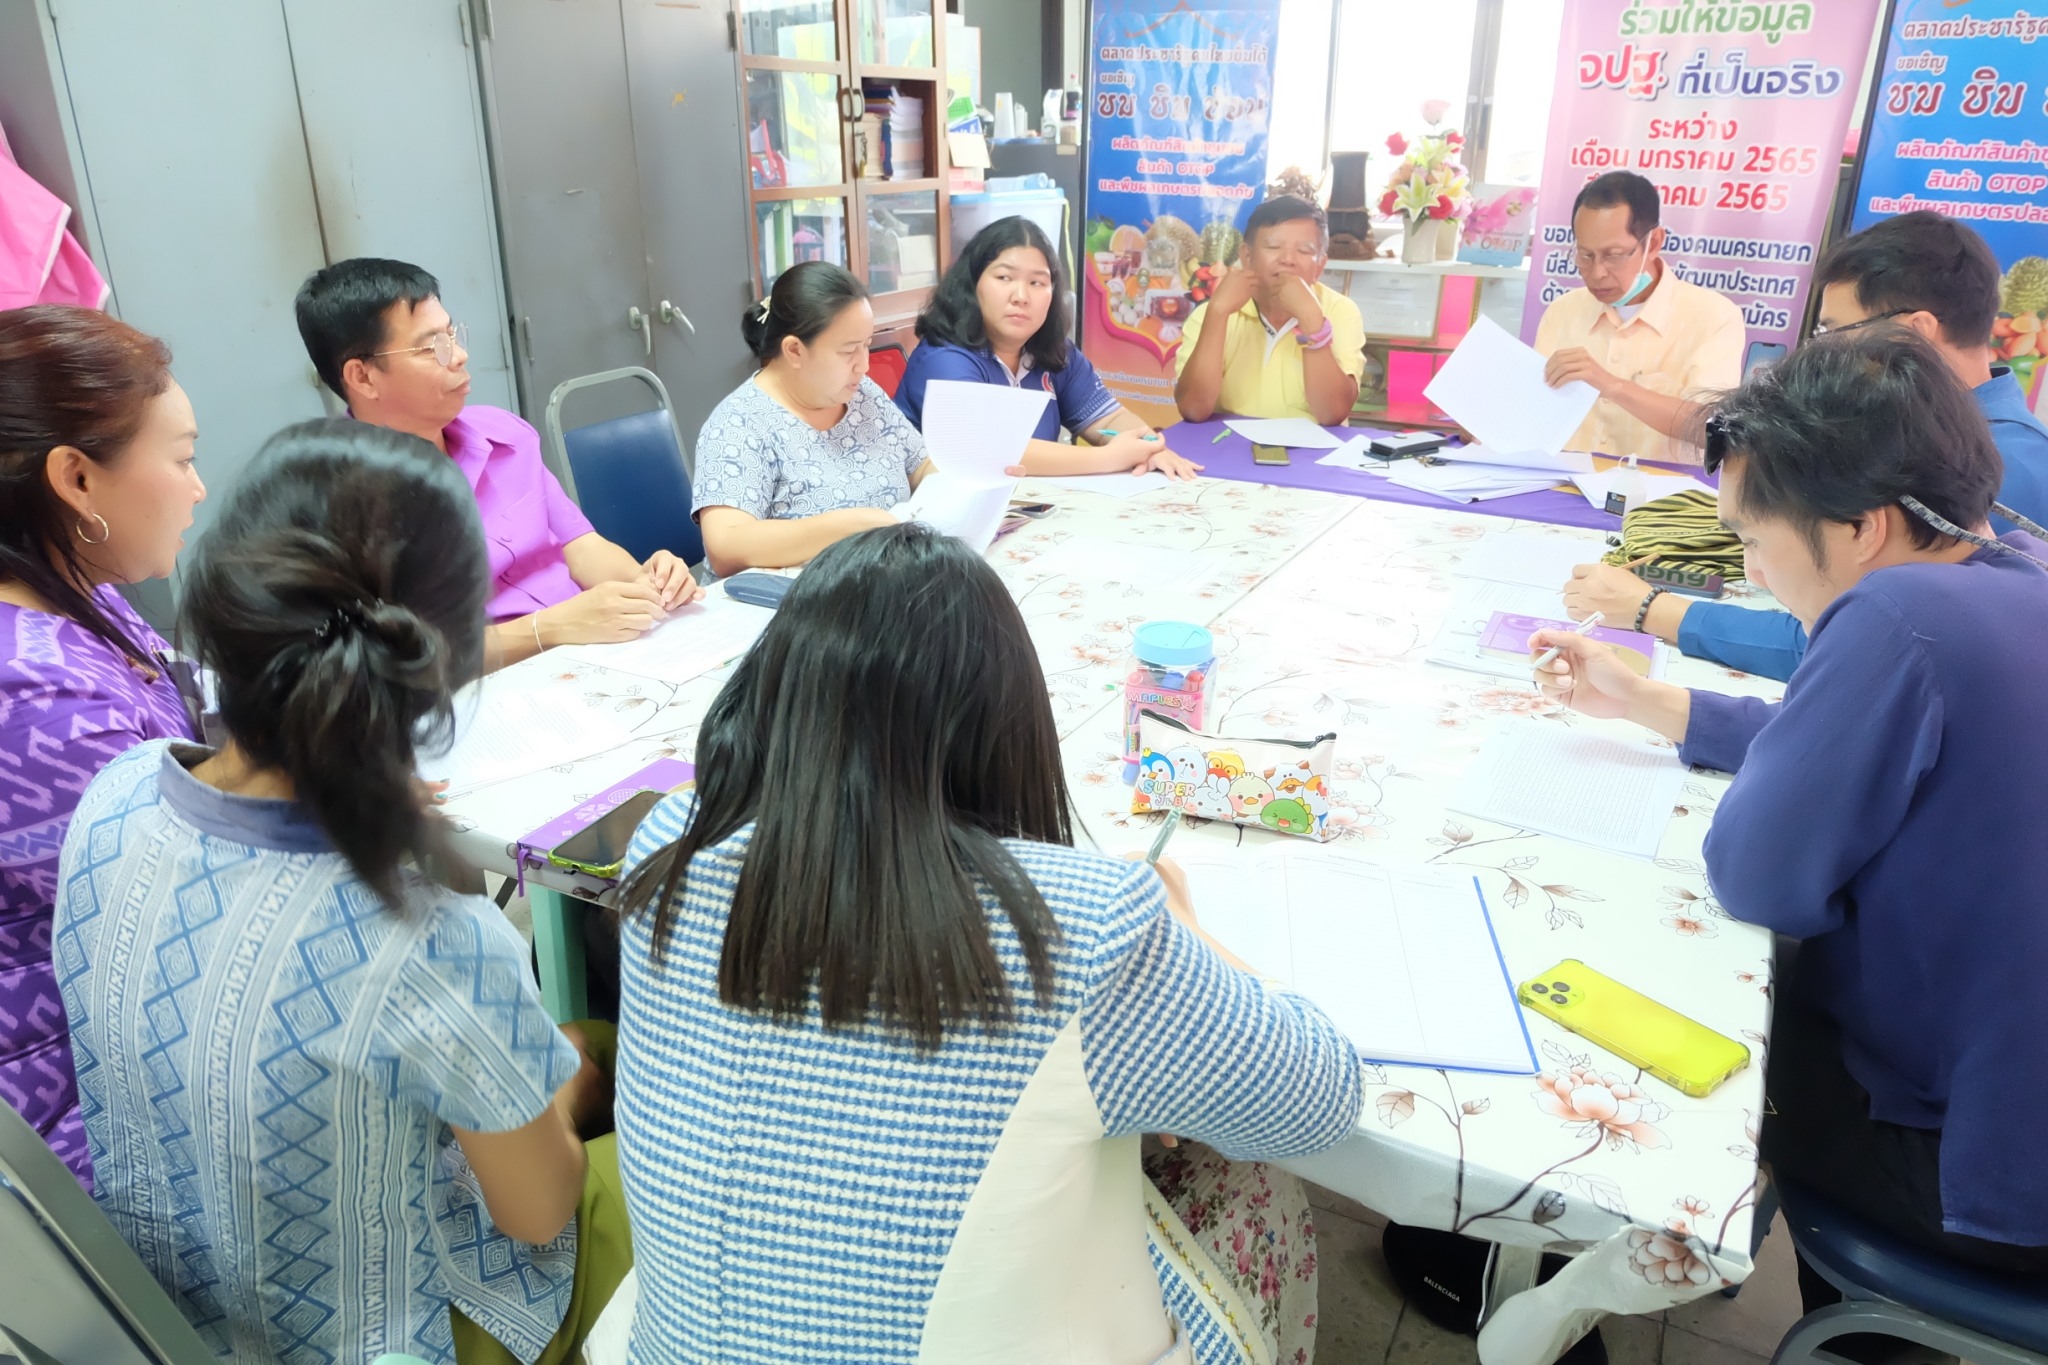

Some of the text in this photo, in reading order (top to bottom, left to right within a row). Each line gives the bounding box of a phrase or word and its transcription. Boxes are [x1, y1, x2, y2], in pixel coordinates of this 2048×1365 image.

[1677, 52, 1841, 95] ที่เป็นจริง
[1898, 53, 1945, 73] ขอเชิญ
[1888, 84, 1943, 114] ชม
[1963, 68, 2024, 115] ชิม
[1099, 94, 1135, 117] ชม
[1649, 111, 1738, 140] ระหว่าง
[1571, 138, 1818, 173] เดือน มกราคม 2565
[1928, 171, 2046, 193] สินค้า OTOP
[1716, 182, 1789, 211] 2565
[1143, 779, 1197, 798] SUPER
[1423, 1276, 1460, 1302] BALENCIAGA
